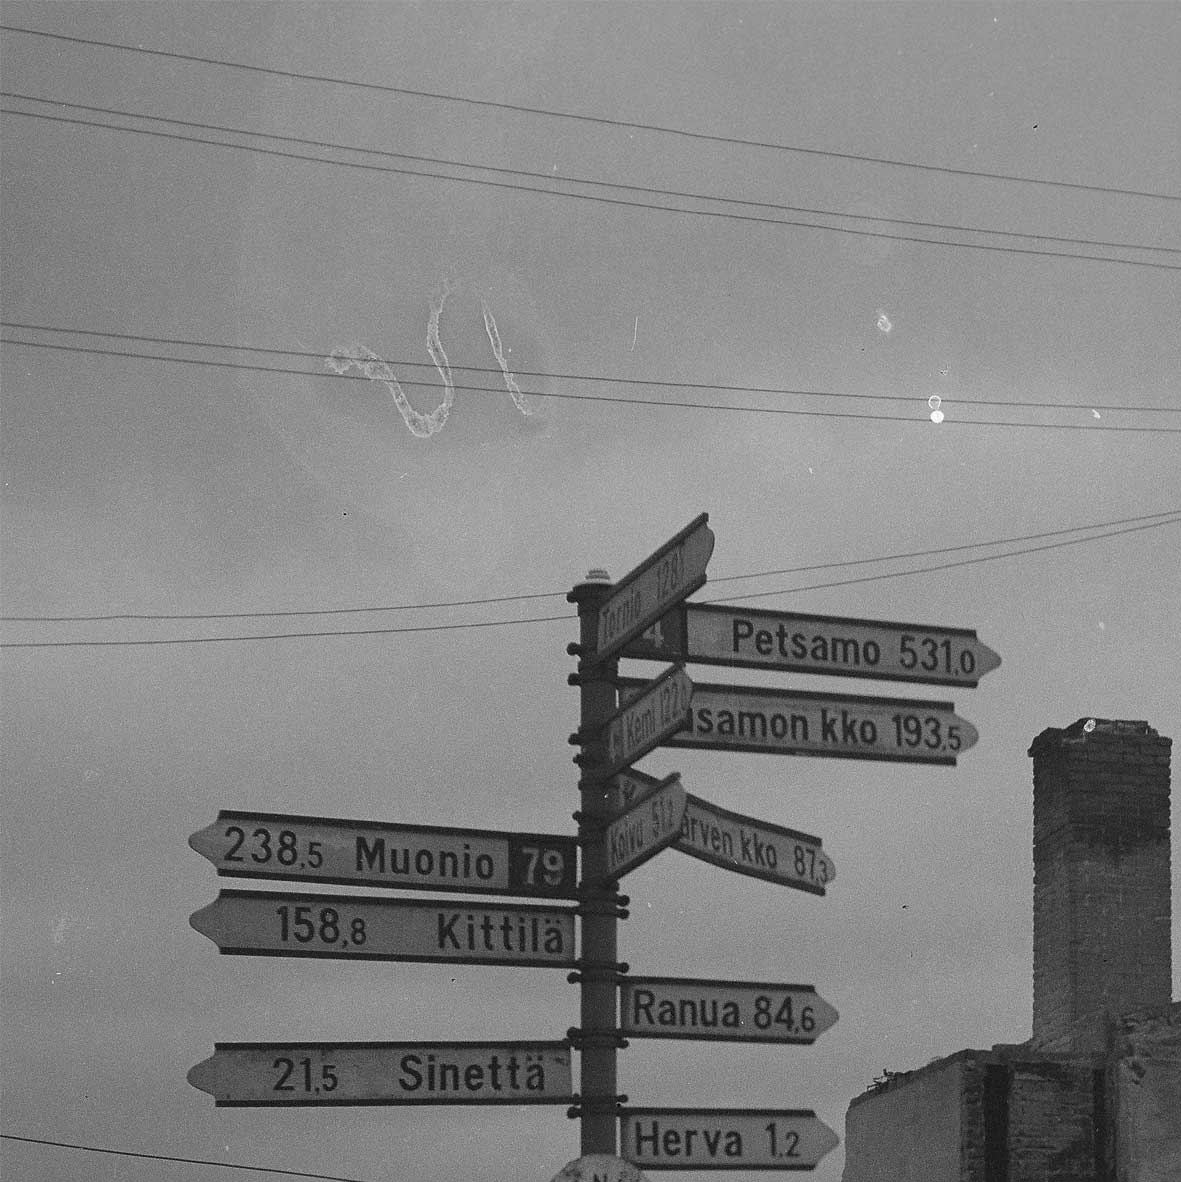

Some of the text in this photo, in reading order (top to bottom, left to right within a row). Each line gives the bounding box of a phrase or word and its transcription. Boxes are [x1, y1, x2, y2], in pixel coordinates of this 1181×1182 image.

[732, 619, 880, 666] Petsamo
[686, 706, 809, 742] samon
[821, 708, 878, 743] kko
[355, 836, 495, 881] Muonio
[521, 846, 565, 887] 79
[739, 829, 778, 869] kko
[437, 912, 564, 955] Kittilä
[633, 989, 741, 1028] Ranua
[398, 1054, 546, 1092] Sinettä
[635, 1120, 743, 1157] Herva
